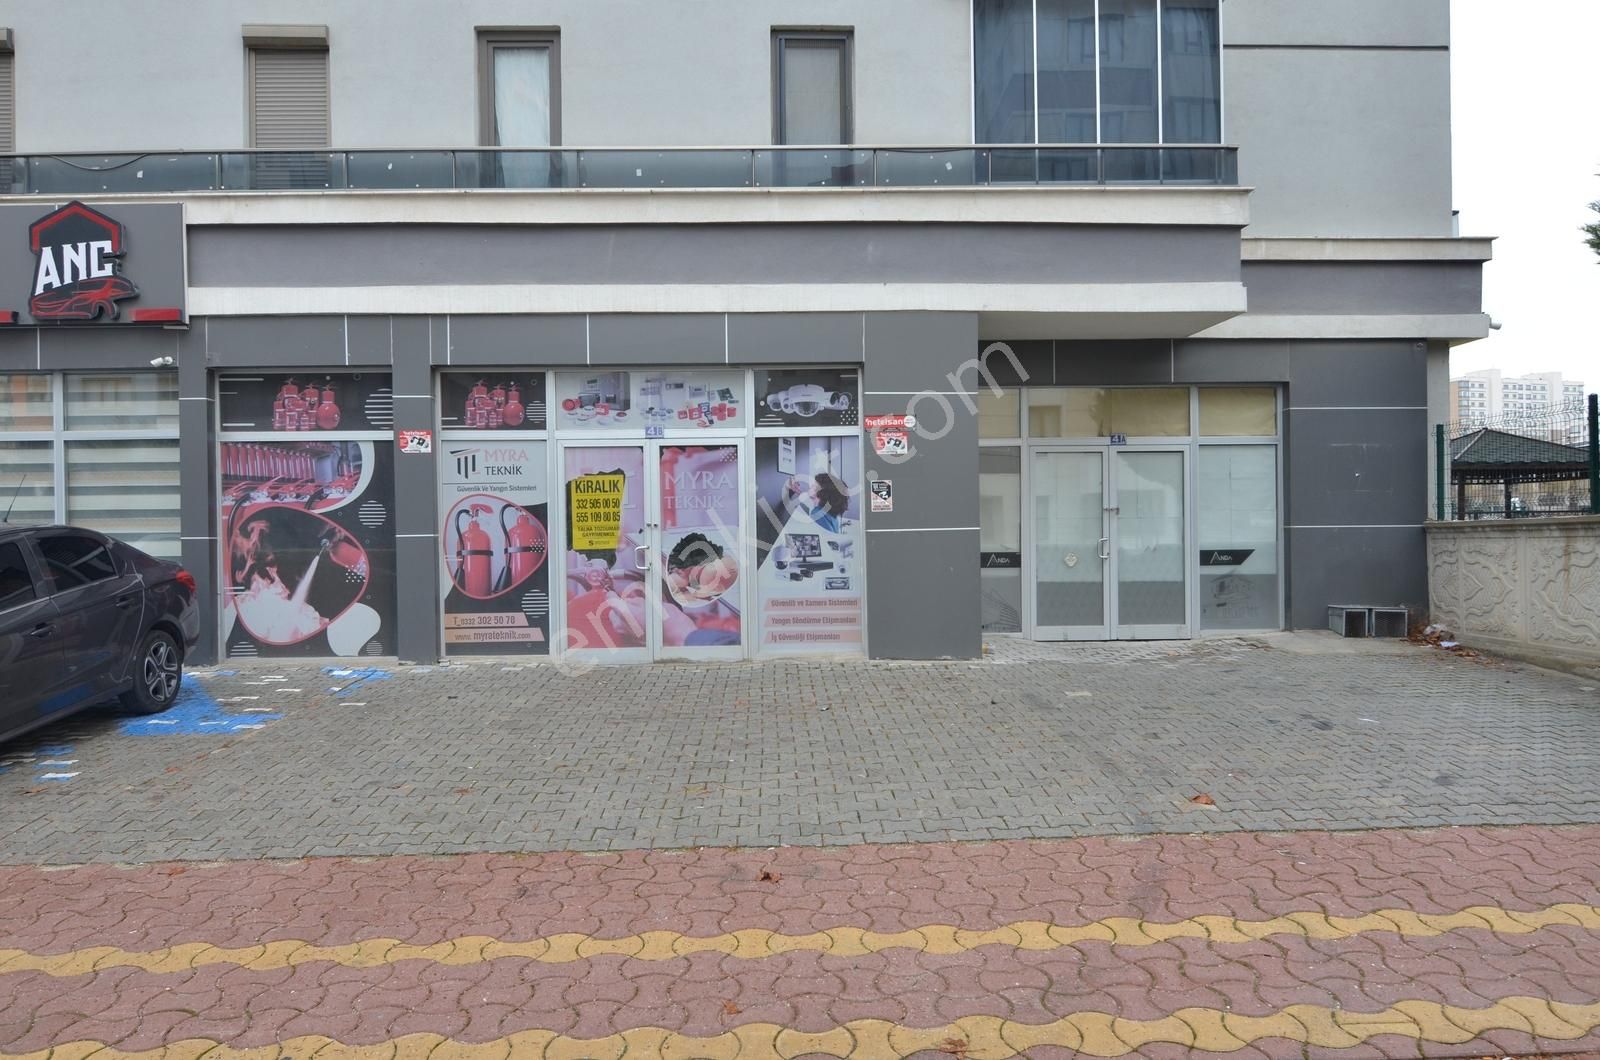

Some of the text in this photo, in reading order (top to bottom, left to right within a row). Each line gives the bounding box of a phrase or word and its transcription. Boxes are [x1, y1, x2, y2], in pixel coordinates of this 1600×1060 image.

[34, 240, 113, 296] ANC
[484, 449, 528, 461] MYRA
[484, 463, 523, 476] TEKNİK
[664, 471, 735, 490] MYRA
[576, 498, 620, 509] 332 505 00 50
[576, 512, 588, 522] 555
[478, 616, 492, 625] 302
[494, 616, 503, 625] 50
